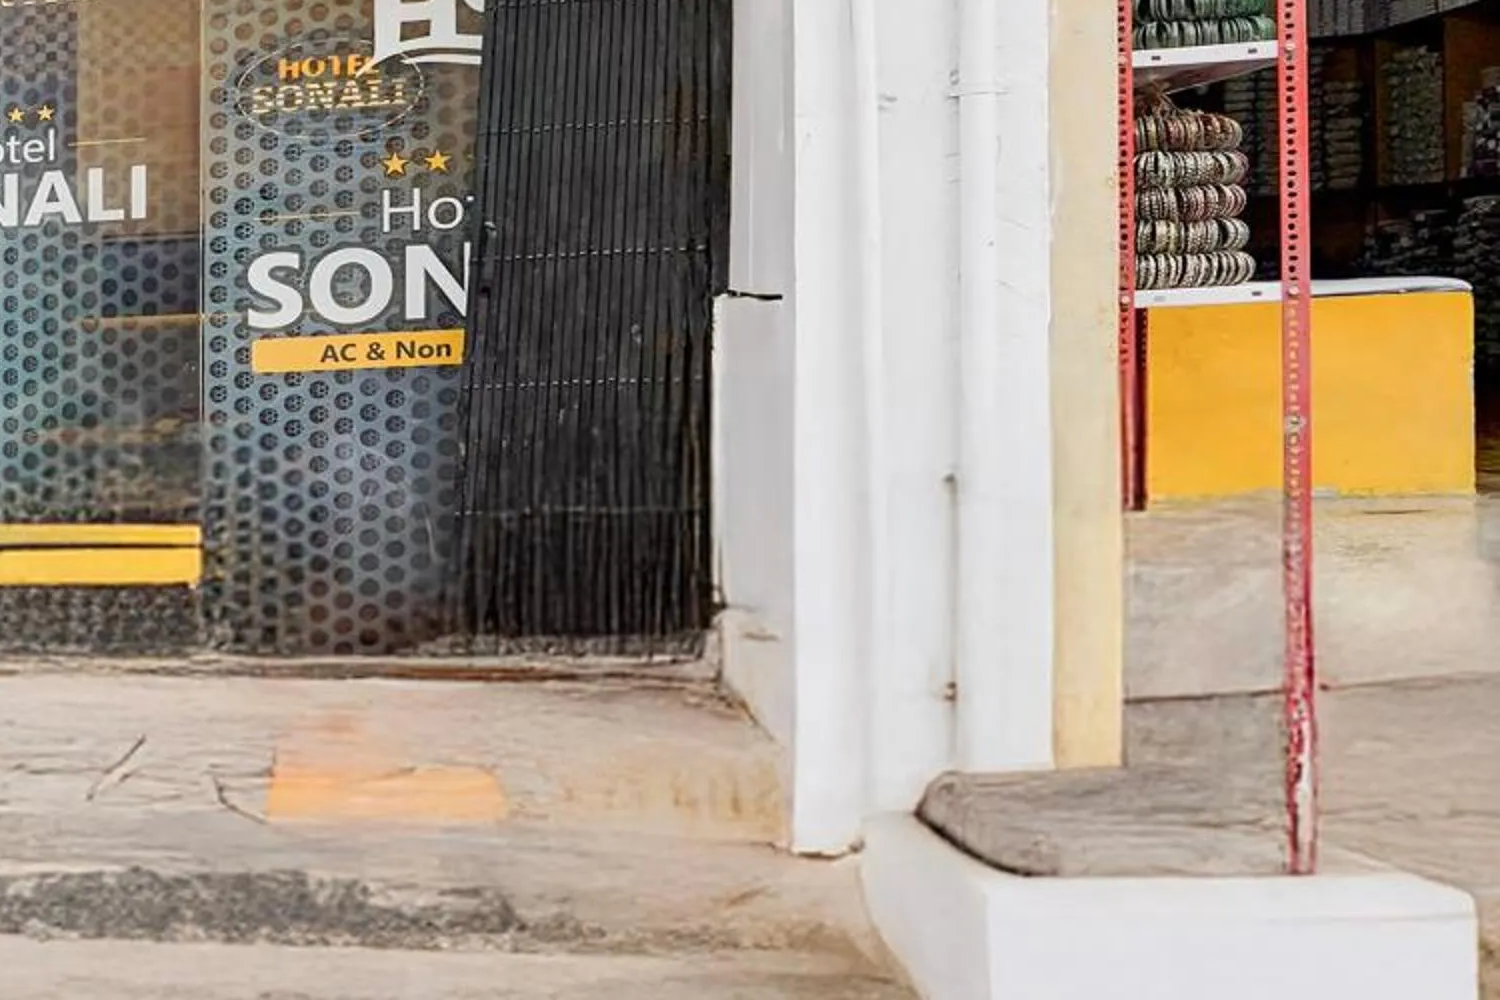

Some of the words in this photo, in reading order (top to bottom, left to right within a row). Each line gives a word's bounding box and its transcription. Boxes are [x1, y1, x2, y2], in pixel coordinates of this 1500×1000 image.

[252, 78, 407, 115] SONALI
[382, 181, 475, 233] Ho
[247, 241, 472, 329] SON
[320, 343, 357, 363] AC
[366, 341, 386, 361] &
[396, 339, 453, 359] Non
